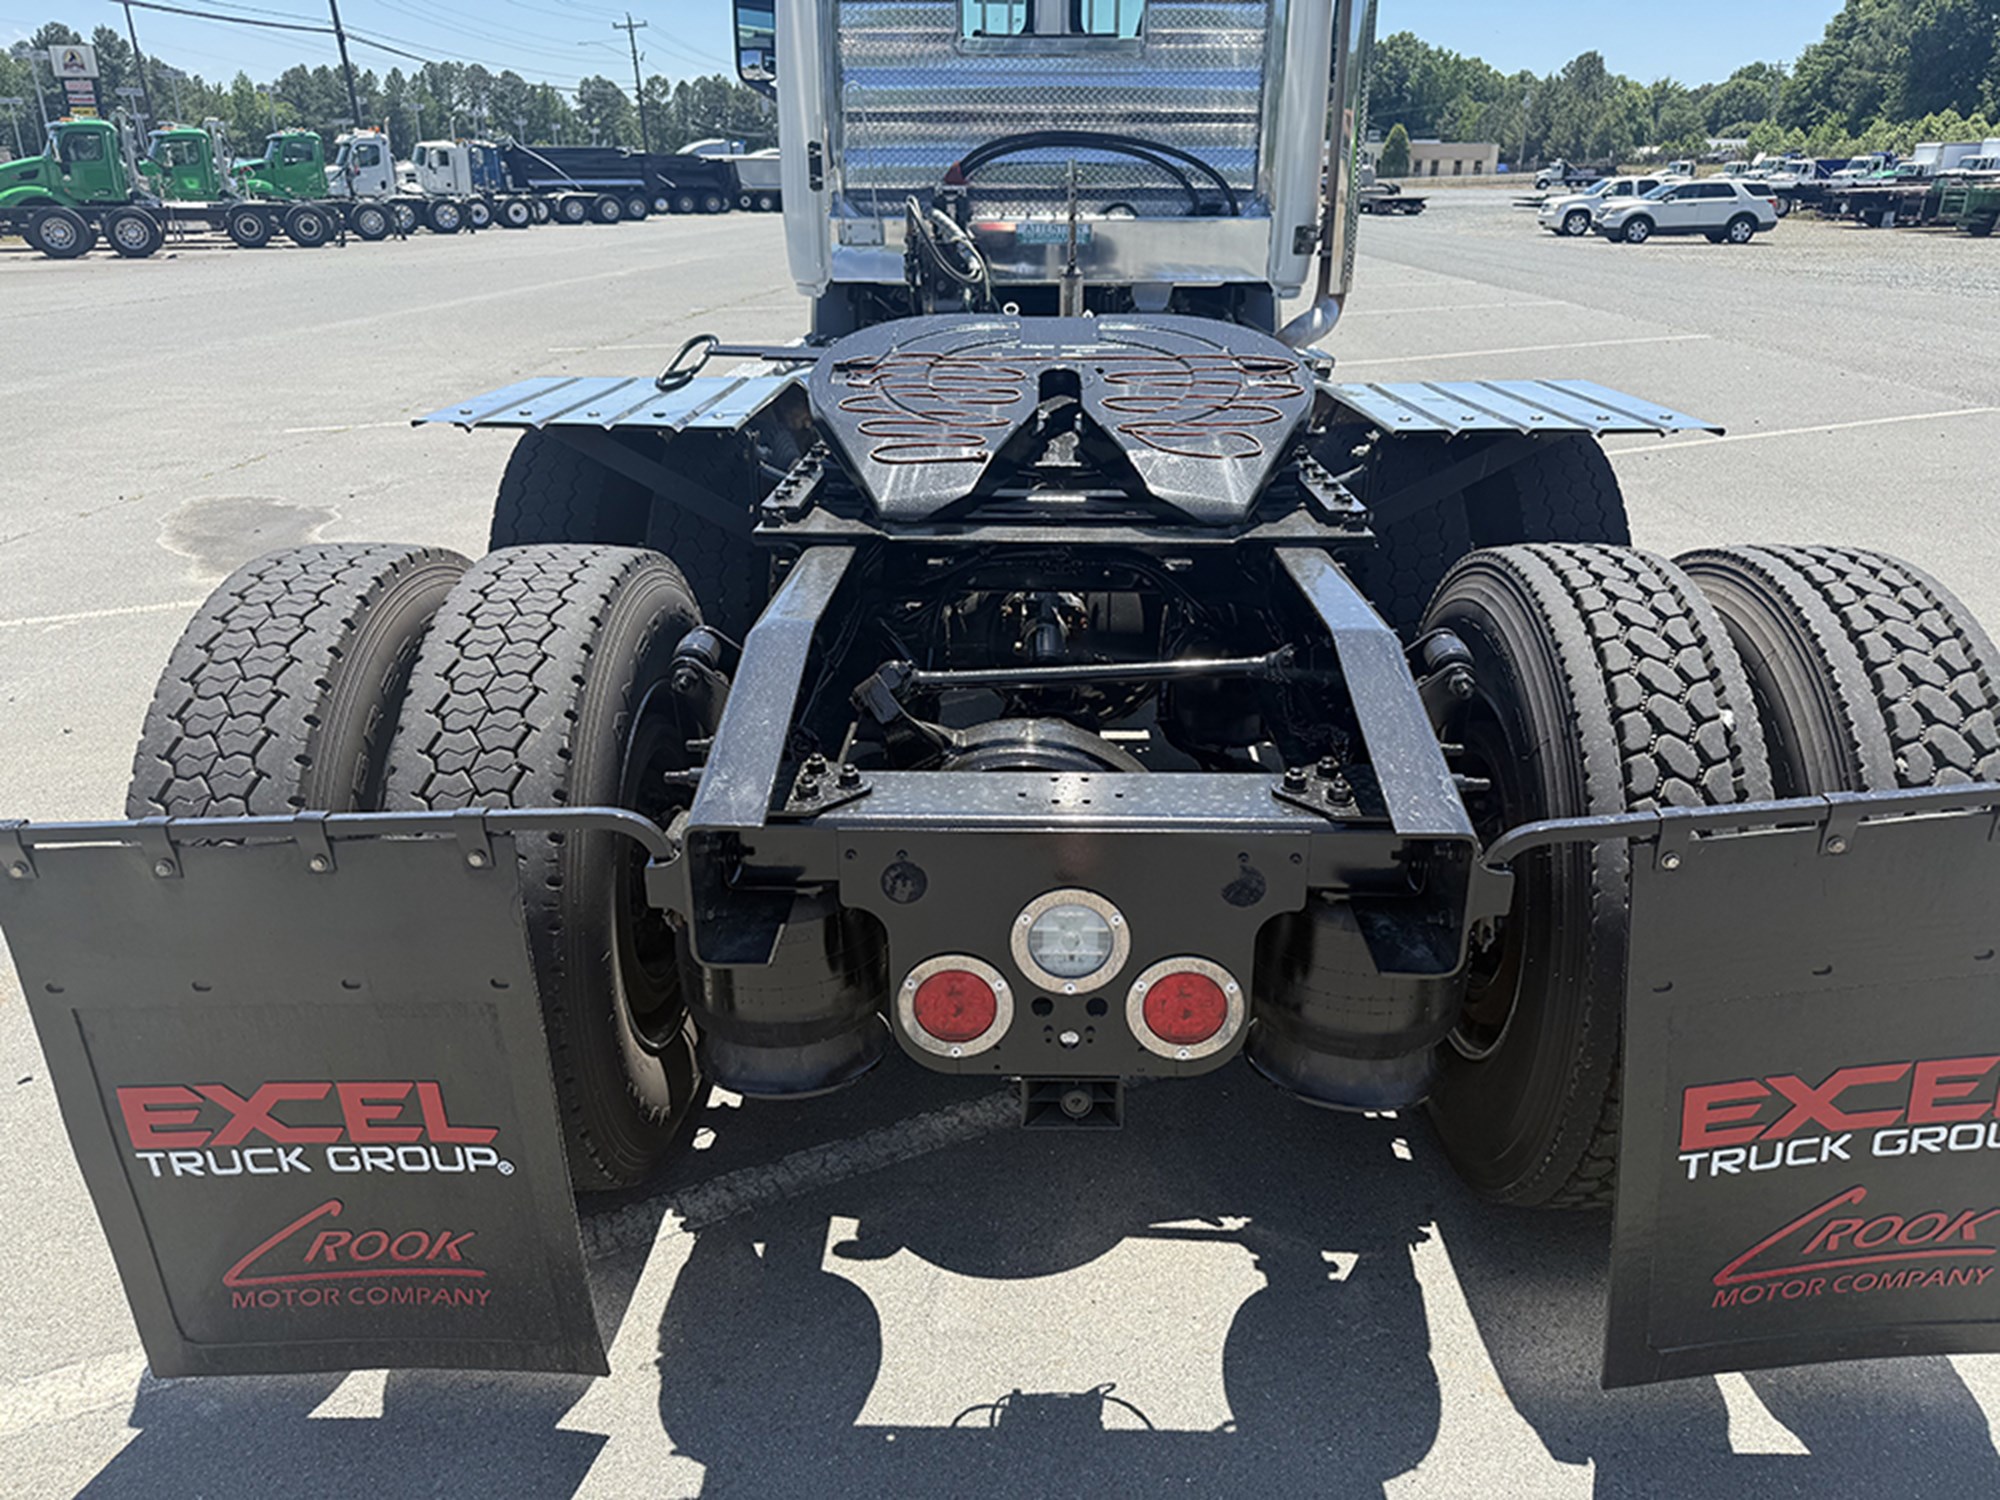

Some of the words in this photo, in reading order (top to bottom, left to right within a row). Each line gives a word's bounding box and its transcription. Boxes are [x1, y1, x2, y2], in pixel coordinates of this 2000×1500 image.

[117, 1082, 498, 1149] EXCEL
[1680, 1056, 2000, 1150] EXCE
[136, 1147, 311, 1176] TRUCK
[1679, 1134, 1852, 1179] TRUCK
[233, 1289, 340, 1309] MOTOR
[349, 1287, 491, 1306] COMPANY
[1712, 1278, 1826, 1308] MOTOR
[1832, 1266, 1994, 1294] COMPANY
